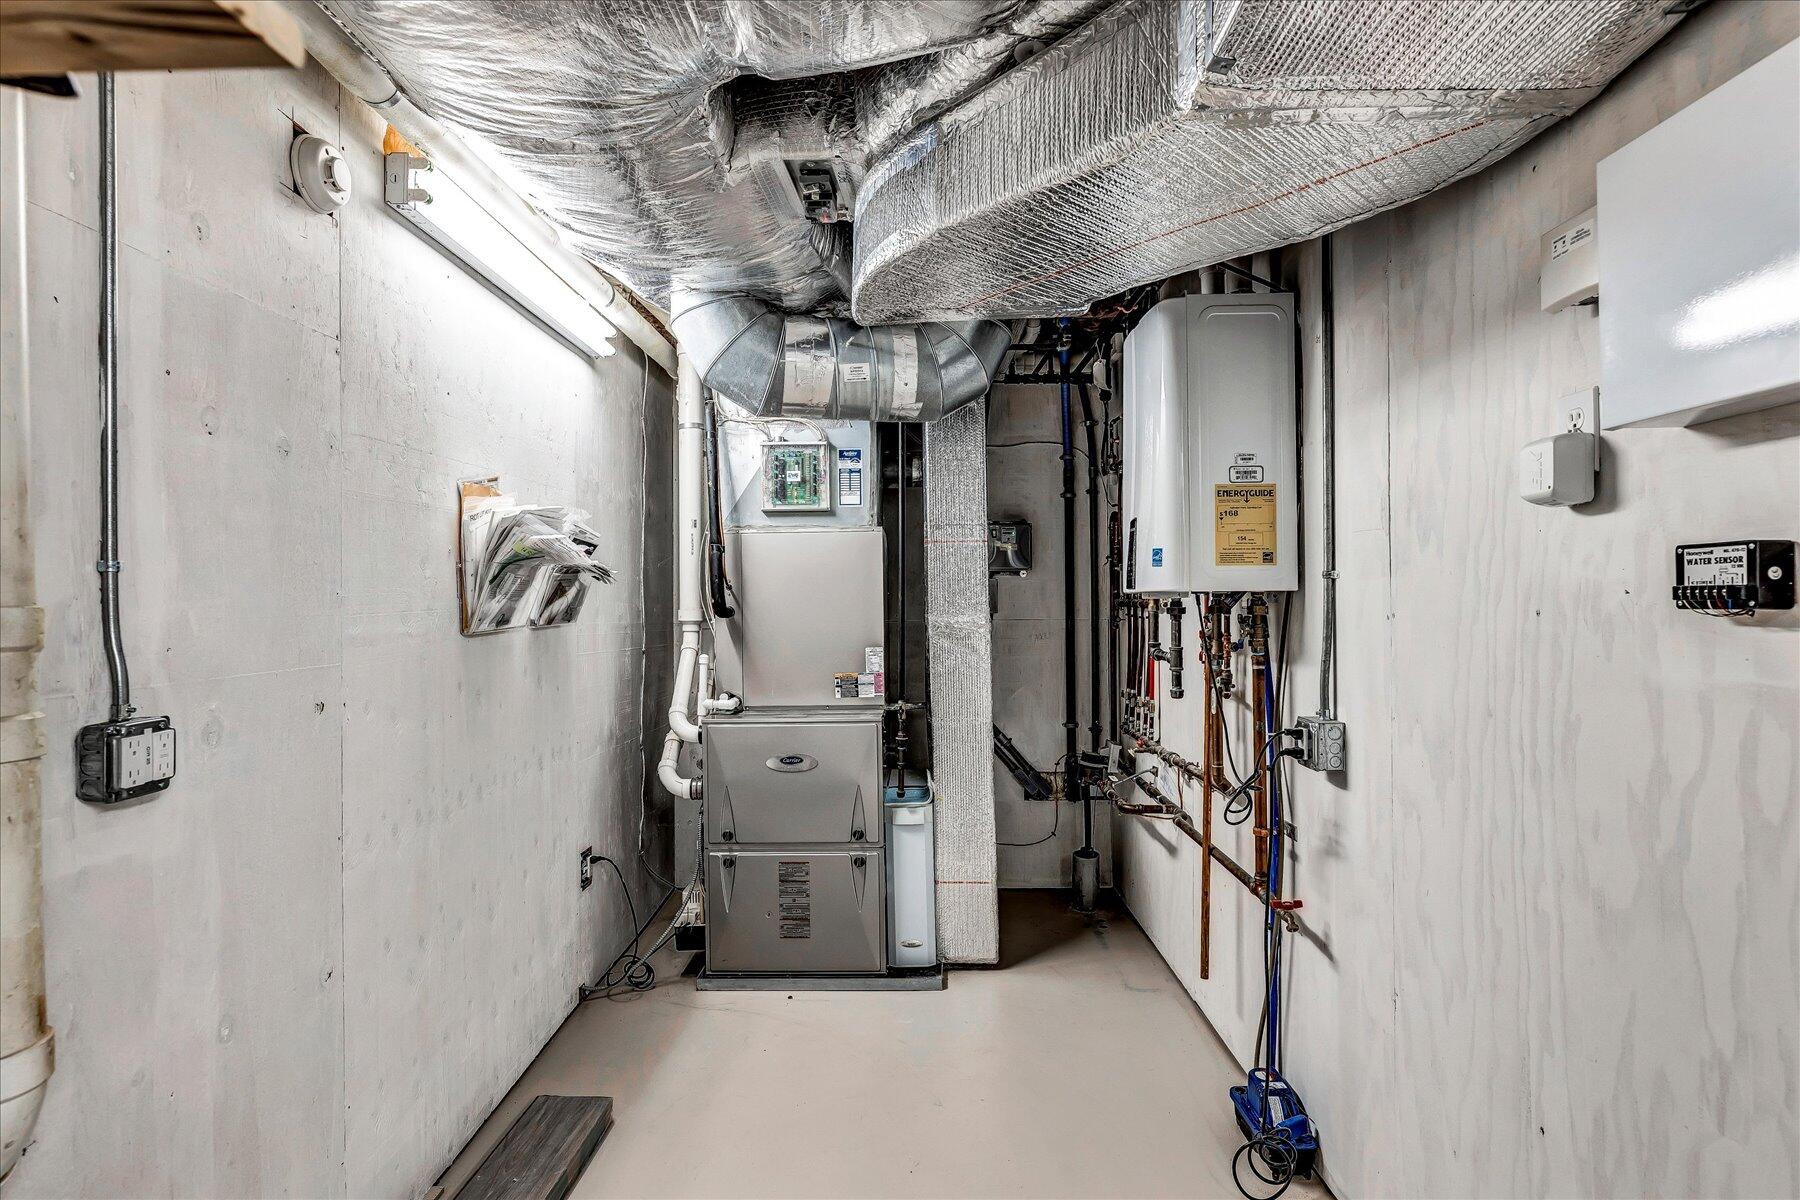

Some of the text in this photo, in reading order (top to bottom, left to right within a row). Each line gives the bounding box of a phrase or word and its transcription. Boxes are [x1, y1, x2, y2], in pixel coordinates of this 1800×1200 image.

[1217, 489, 1275, 498] ENERGYGUIDE
[1686, 556, 1744, 566] WATER SENSOR
